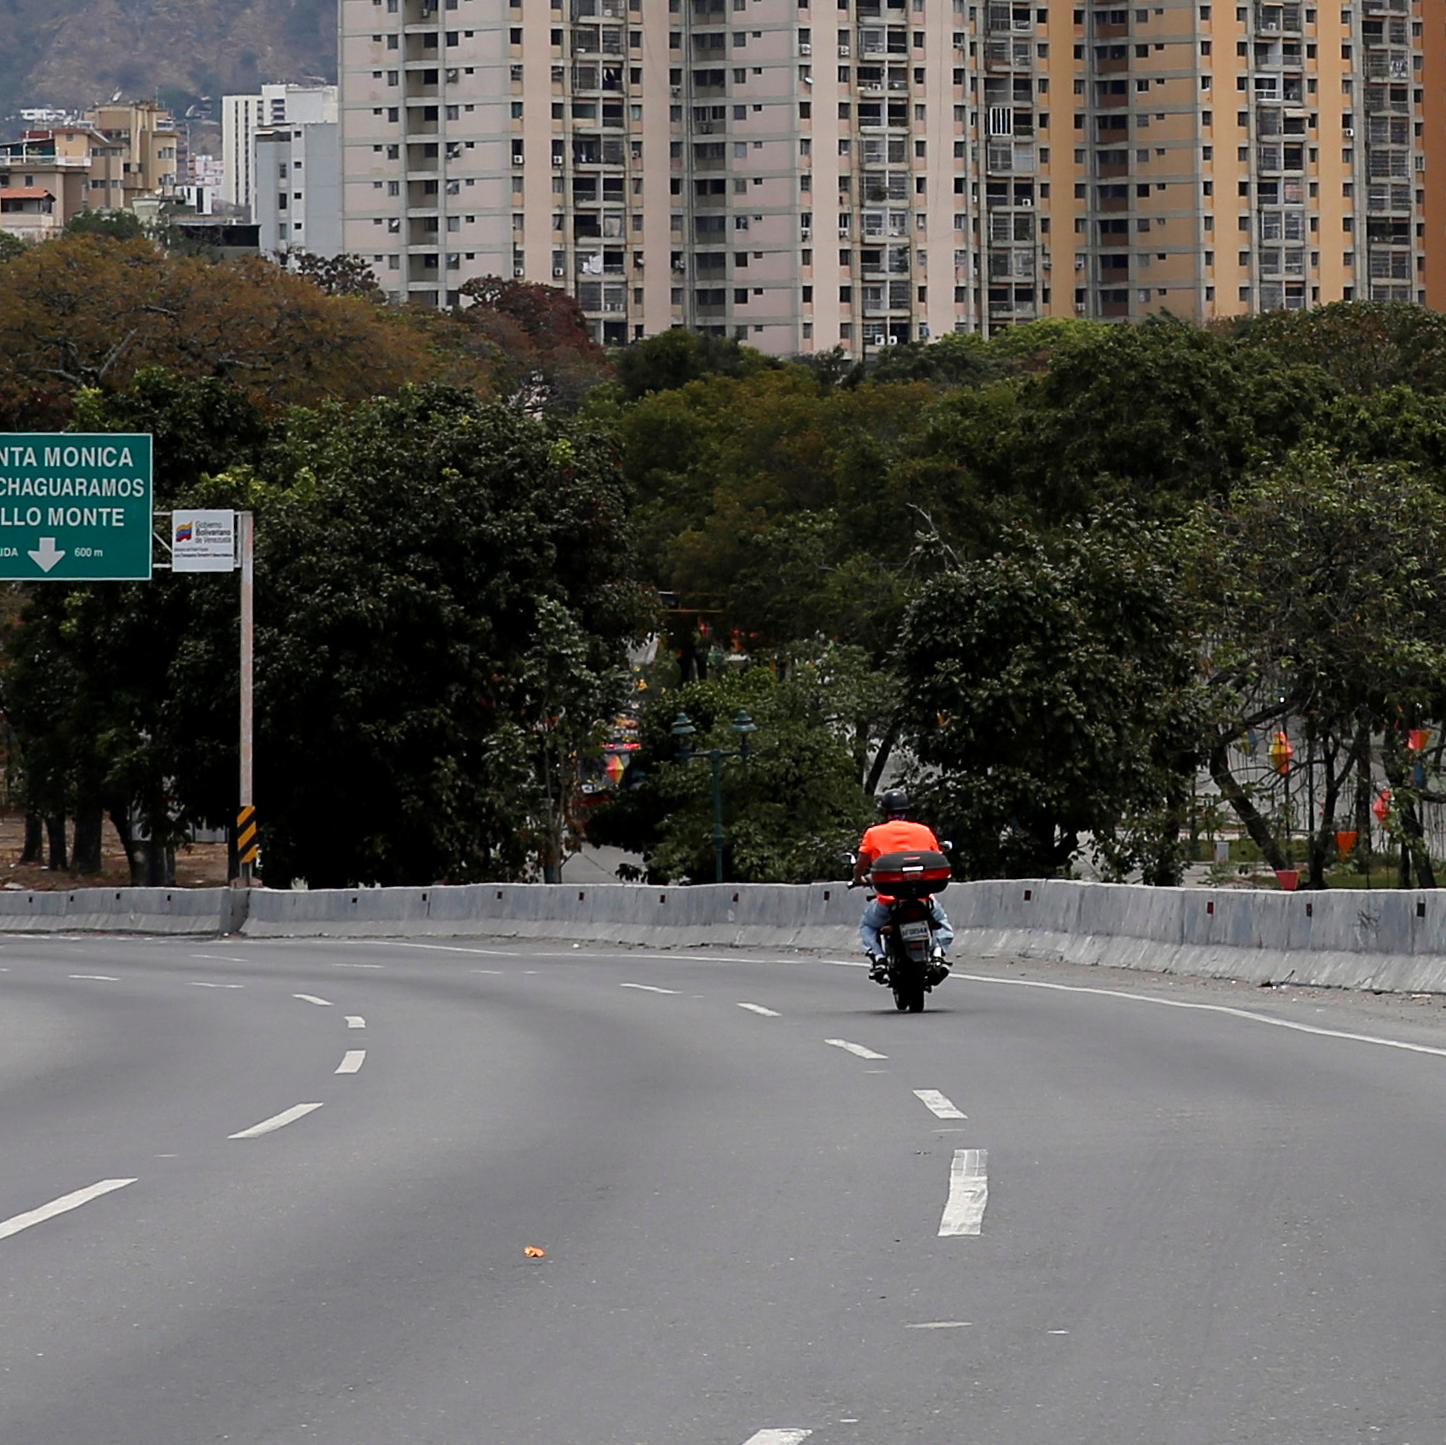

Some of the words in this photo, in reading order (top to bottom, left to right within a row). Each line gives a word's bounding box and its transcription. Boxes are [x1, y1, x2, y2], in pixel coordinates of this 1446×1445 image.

[44, 446, 134, 468] MONICA
[48, 507, 125, 527] MONTE
[74, 547, 92, 558] 600
[93, 549, 104, 557] m
